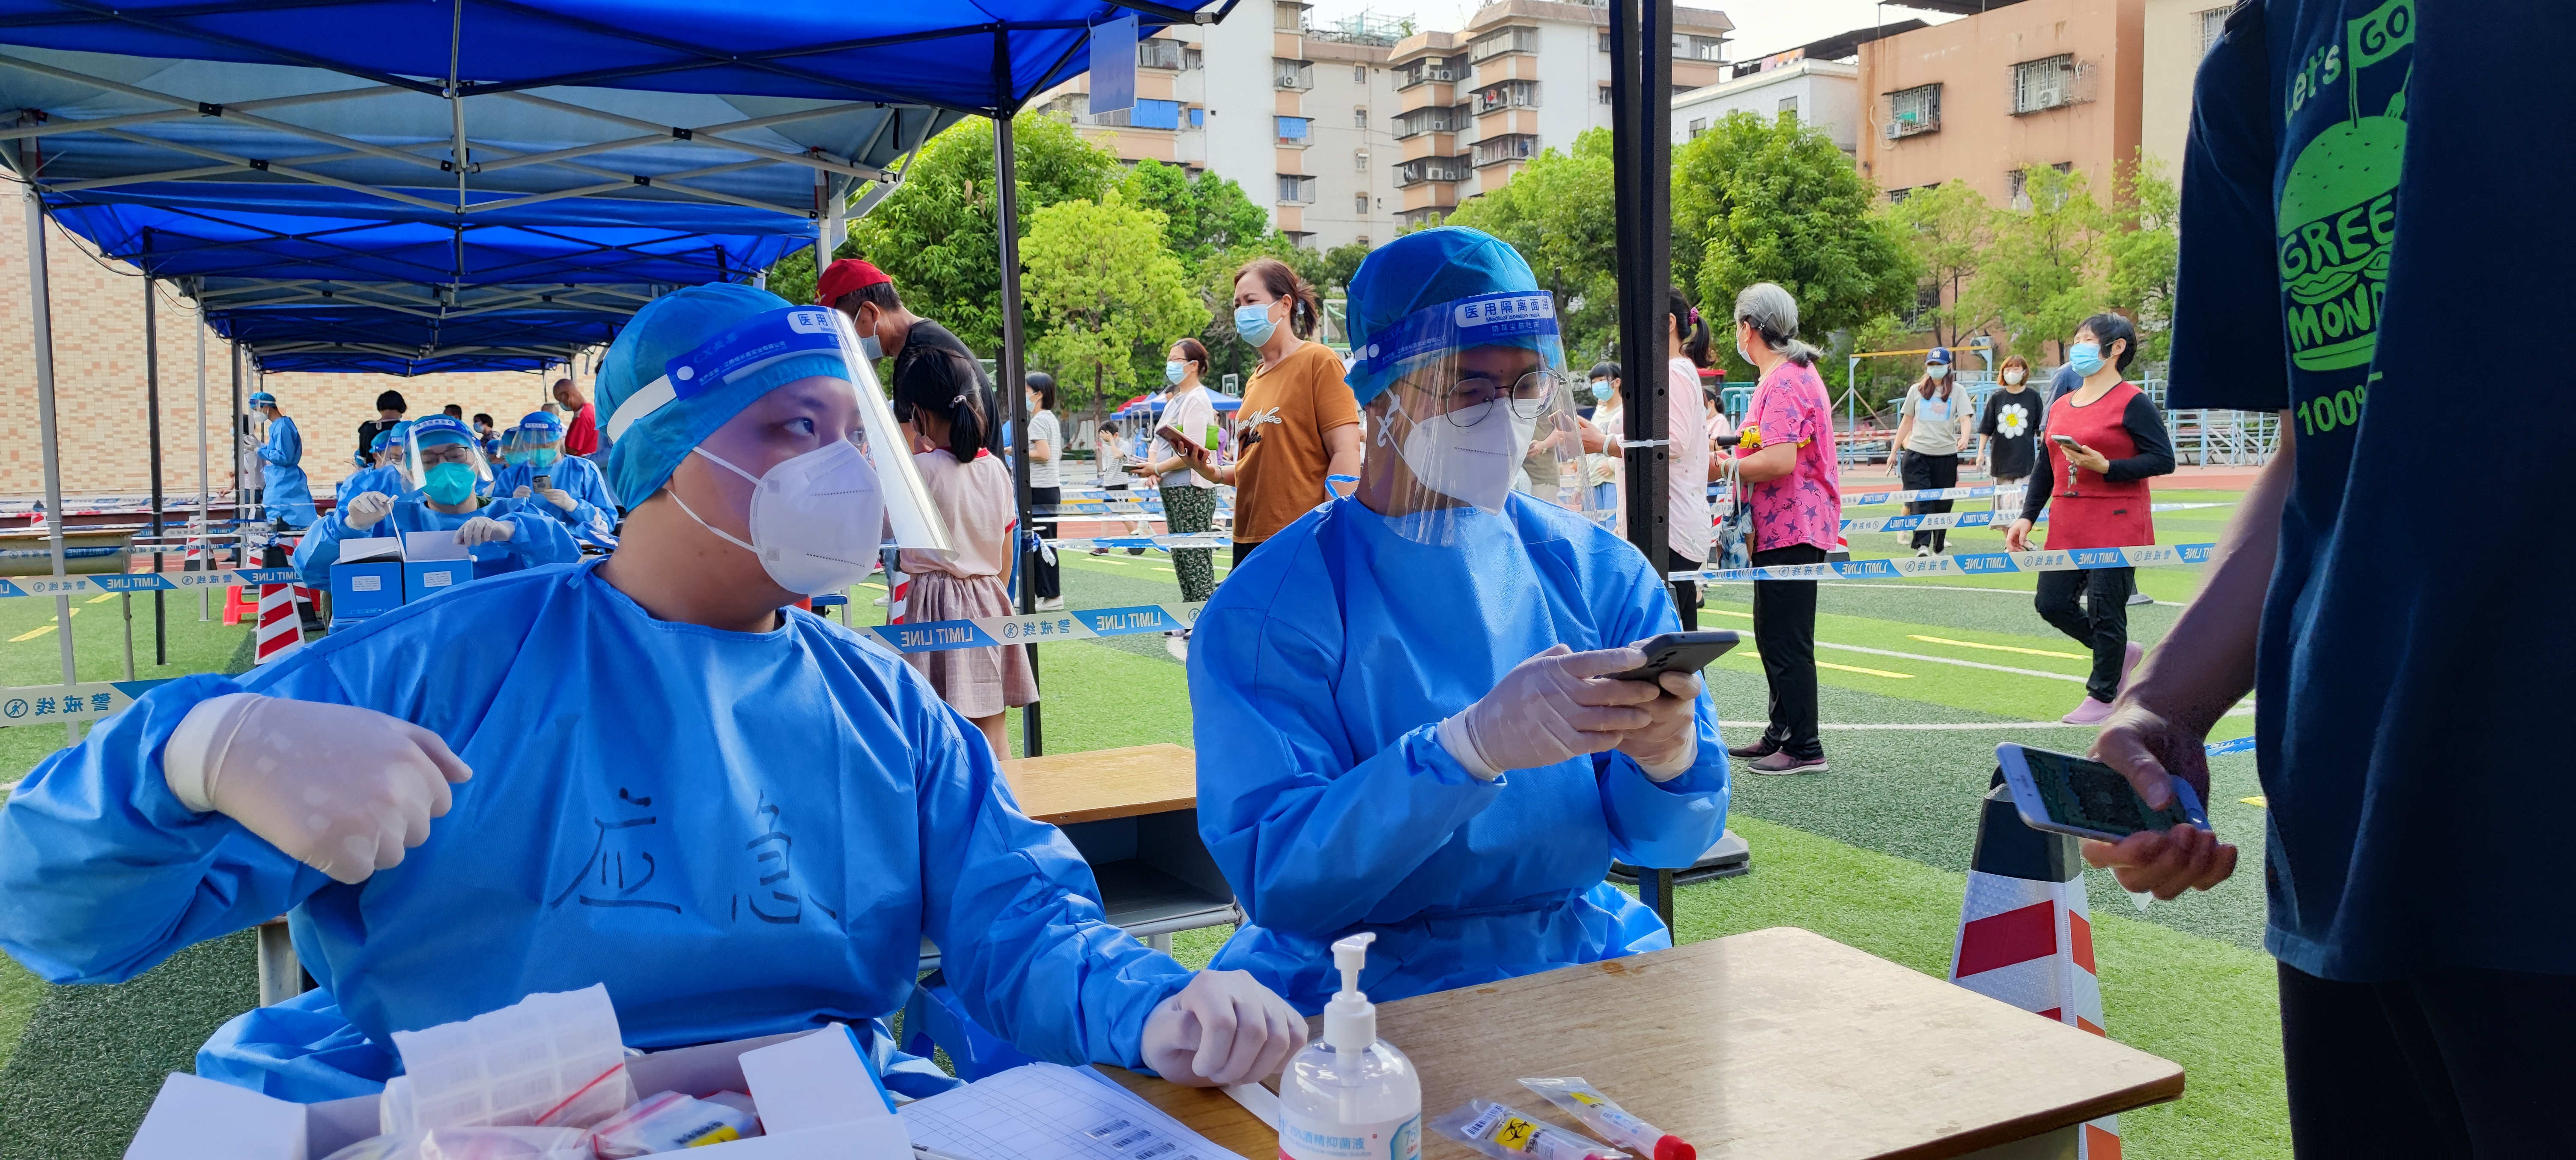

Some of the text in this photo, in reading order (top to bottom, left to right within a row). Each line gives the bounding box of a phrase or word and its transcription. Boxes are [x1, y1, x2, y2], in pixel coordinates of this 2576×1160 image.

[2360, 4, 2409, 54] GO
[1465, 298, 1549, 319] 医用隔离面罩
[797, 314, 833, 326] 医用
[1890, 518, 1918, 528] LIMIT LINE
[1962, 514, 1989, 524] LIMIT LINE
[549, 787, 836, 924] 应急
